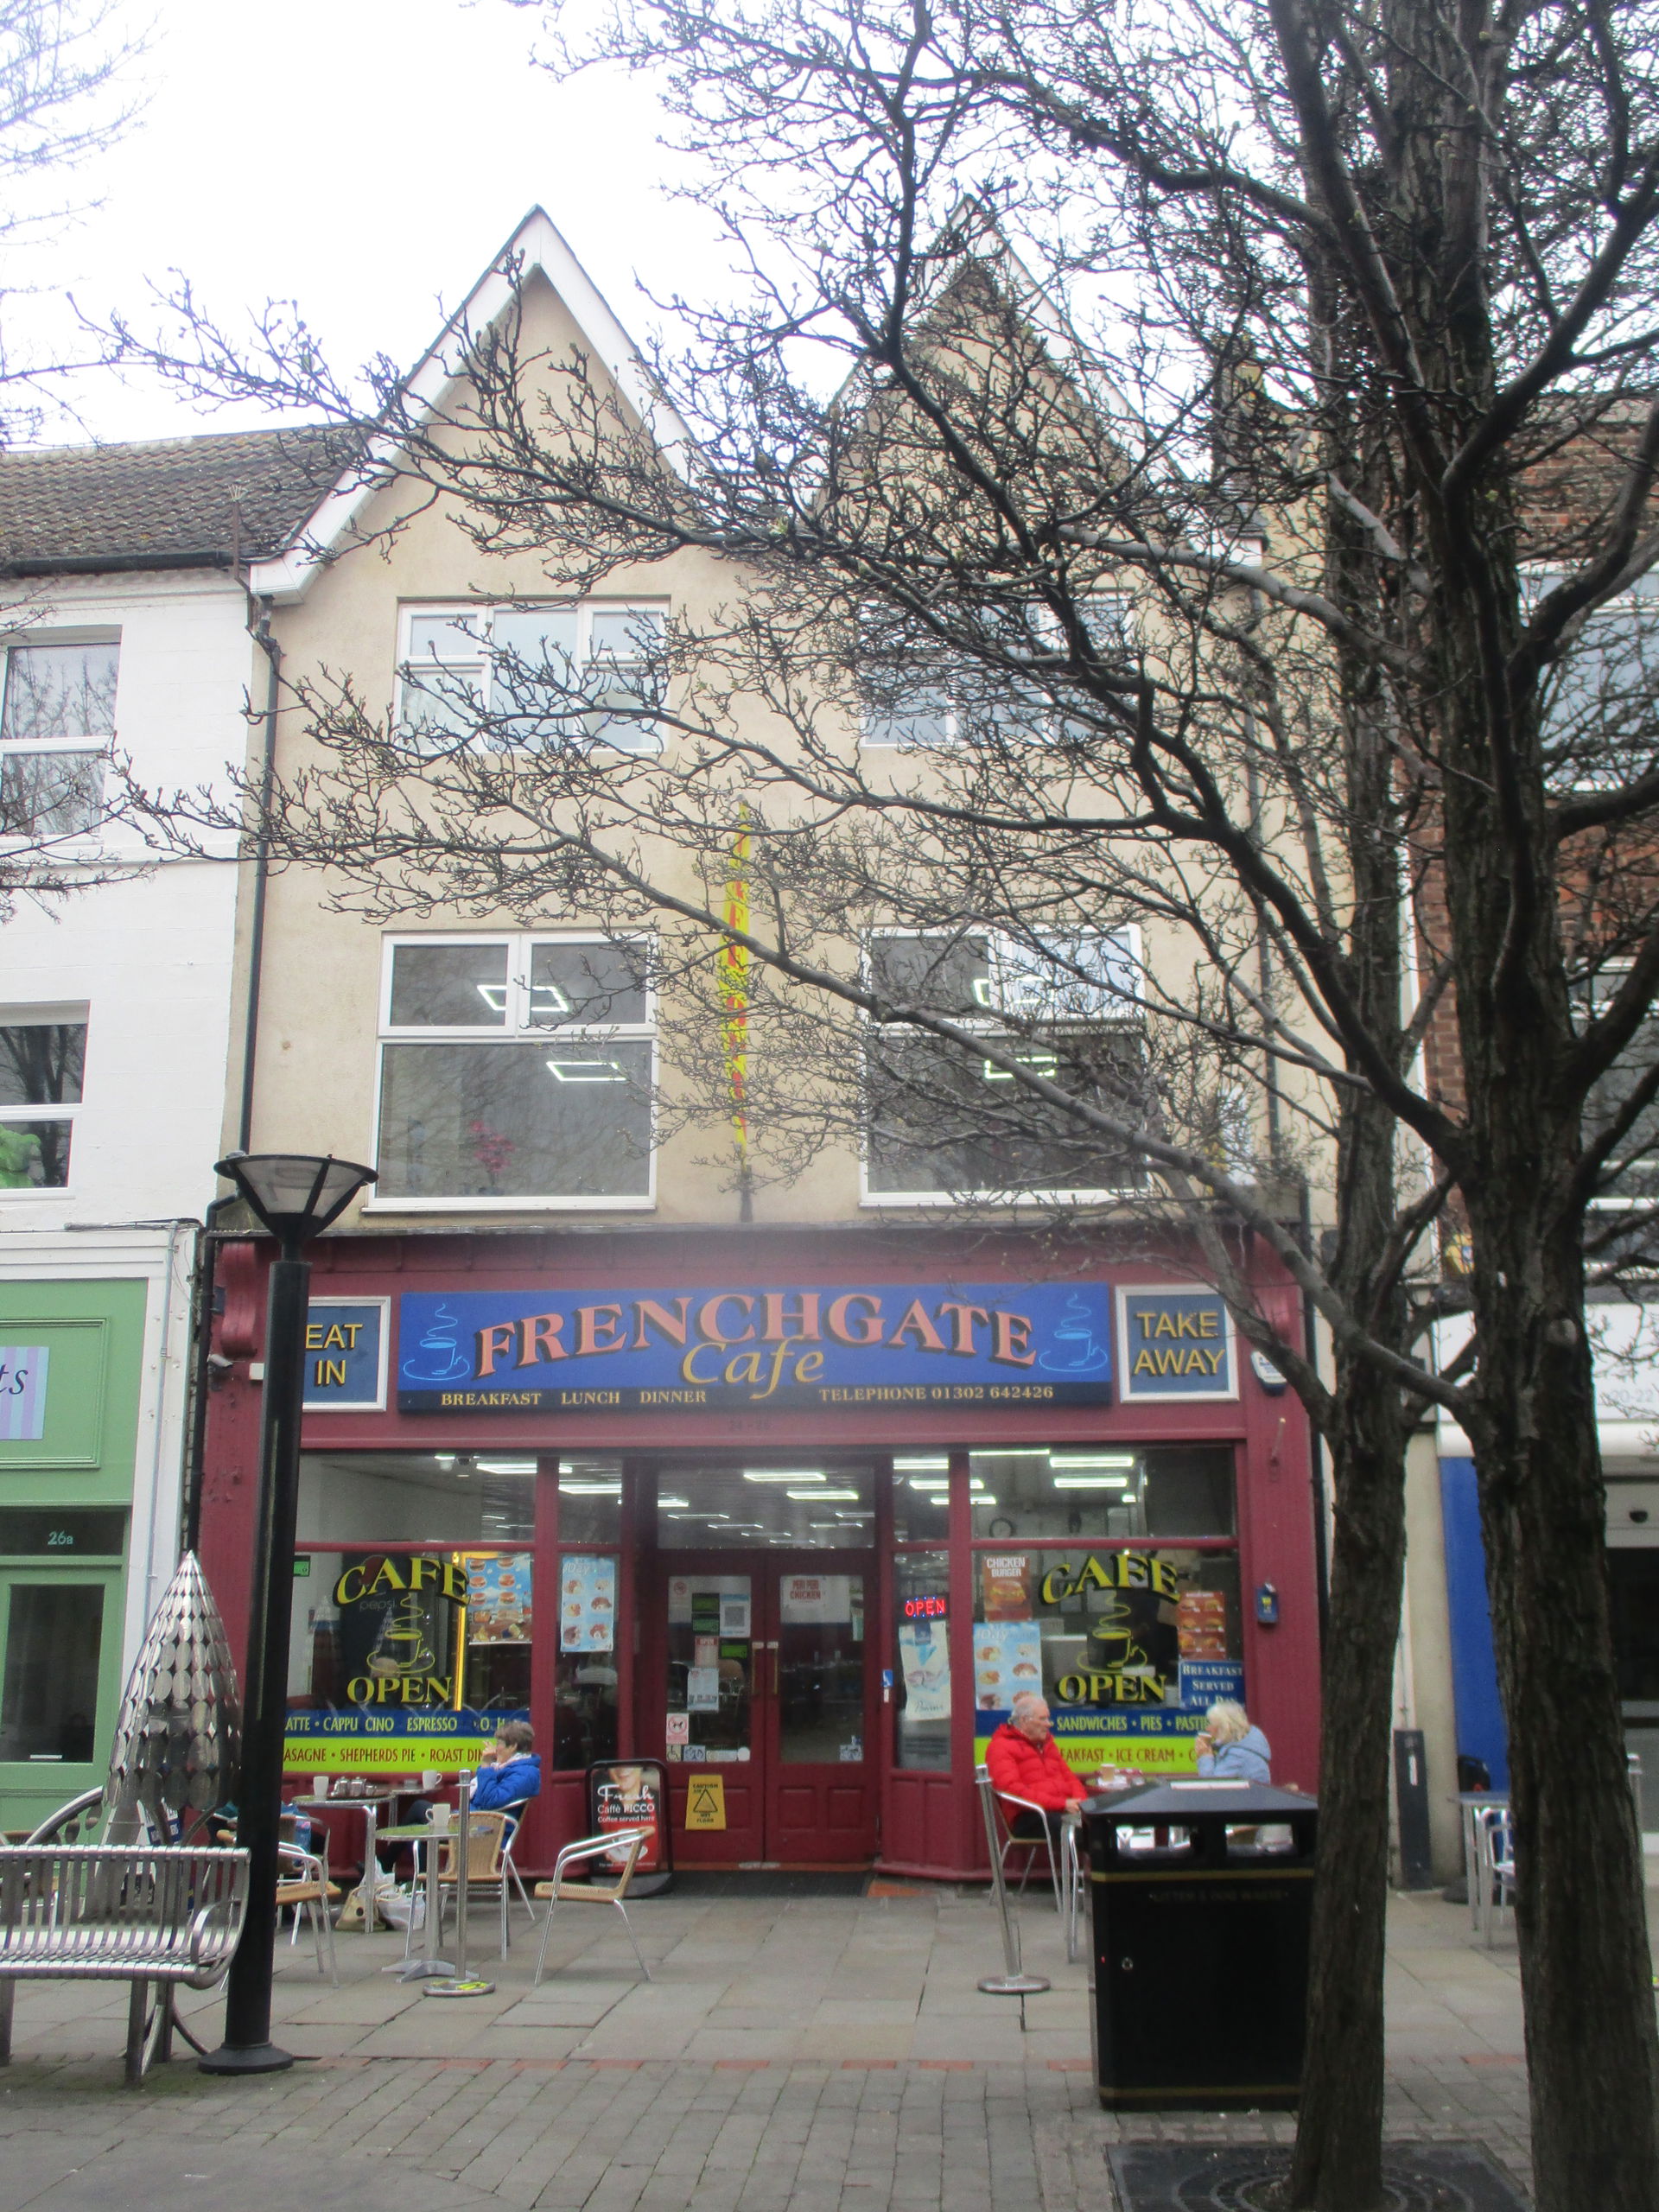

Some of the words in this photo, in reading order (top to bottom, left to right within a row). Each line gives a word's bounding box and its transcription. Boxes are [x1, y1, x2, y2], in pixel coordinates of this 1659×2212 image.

[1136, 1311, 1218, 1338] TAKE
[306, 1324, 363, 1349] EAT
[478, 1293, 1036, 1377] FRENCHGATE
[682, 1335, 824, 1400] Cafe
[1134, 1348, 1224, 1375] AWAY
[317, 1359, 346, 1384] IN
[441, 1391, 542, 1406] BREAKFAST
[561, 1390, 620, 1405] LUNCH
[639, 1389, 707, 1404] DINNER
[818, 1388, 926, 1402] TELEPHONE
[931, 1387, 984, 1400] 01302
[989, 1385, 1054, 1399] 642426
[48, 1531, 74, 1546] 26a
[986, 1556, 1026, 1568] CHICKEN
[334, 1556, 470, 1605] CAFE
[991, 1568, 1022, 1578] BURGER
[1043, 1554, 1179, 1604] CAFE
[905, 1599, 946, 1617] OPEN
[1182, 1664, 1243, 1675] BREAKFAST
[346, 1677, 453, 1704] OPEN
[1058, 1675, 1167, 1702] OPEN
[1192, 1680, 1235, 1691] SERVED
[284, 1716, 311, 1731] ATTE
[323, 1716, 358, 1732] CAPPU
[365, 1716, 394, 1732] CINO
[406, 1716, 458, 1732] ESPRESSO
[1057, 1716, 1127, 1731] SANDWICHES
[1141, 1716, 1162, 1731] PIES
[283, 1748, 327, 1763] ASAGNE
[340, 1748, 398, 1763] SHEPHERDS
[401, 1748, 416, 1763] PIE
[429, 1748, 464, 1763] ROAST
[1060, 1748, 1104, 1763] EAKFAST
[1116, 1748, 1133, 1763] ICE
[1137, 1748, 1175, 1763] CREAM
[623, 1802, 655, 1814] RICCO
